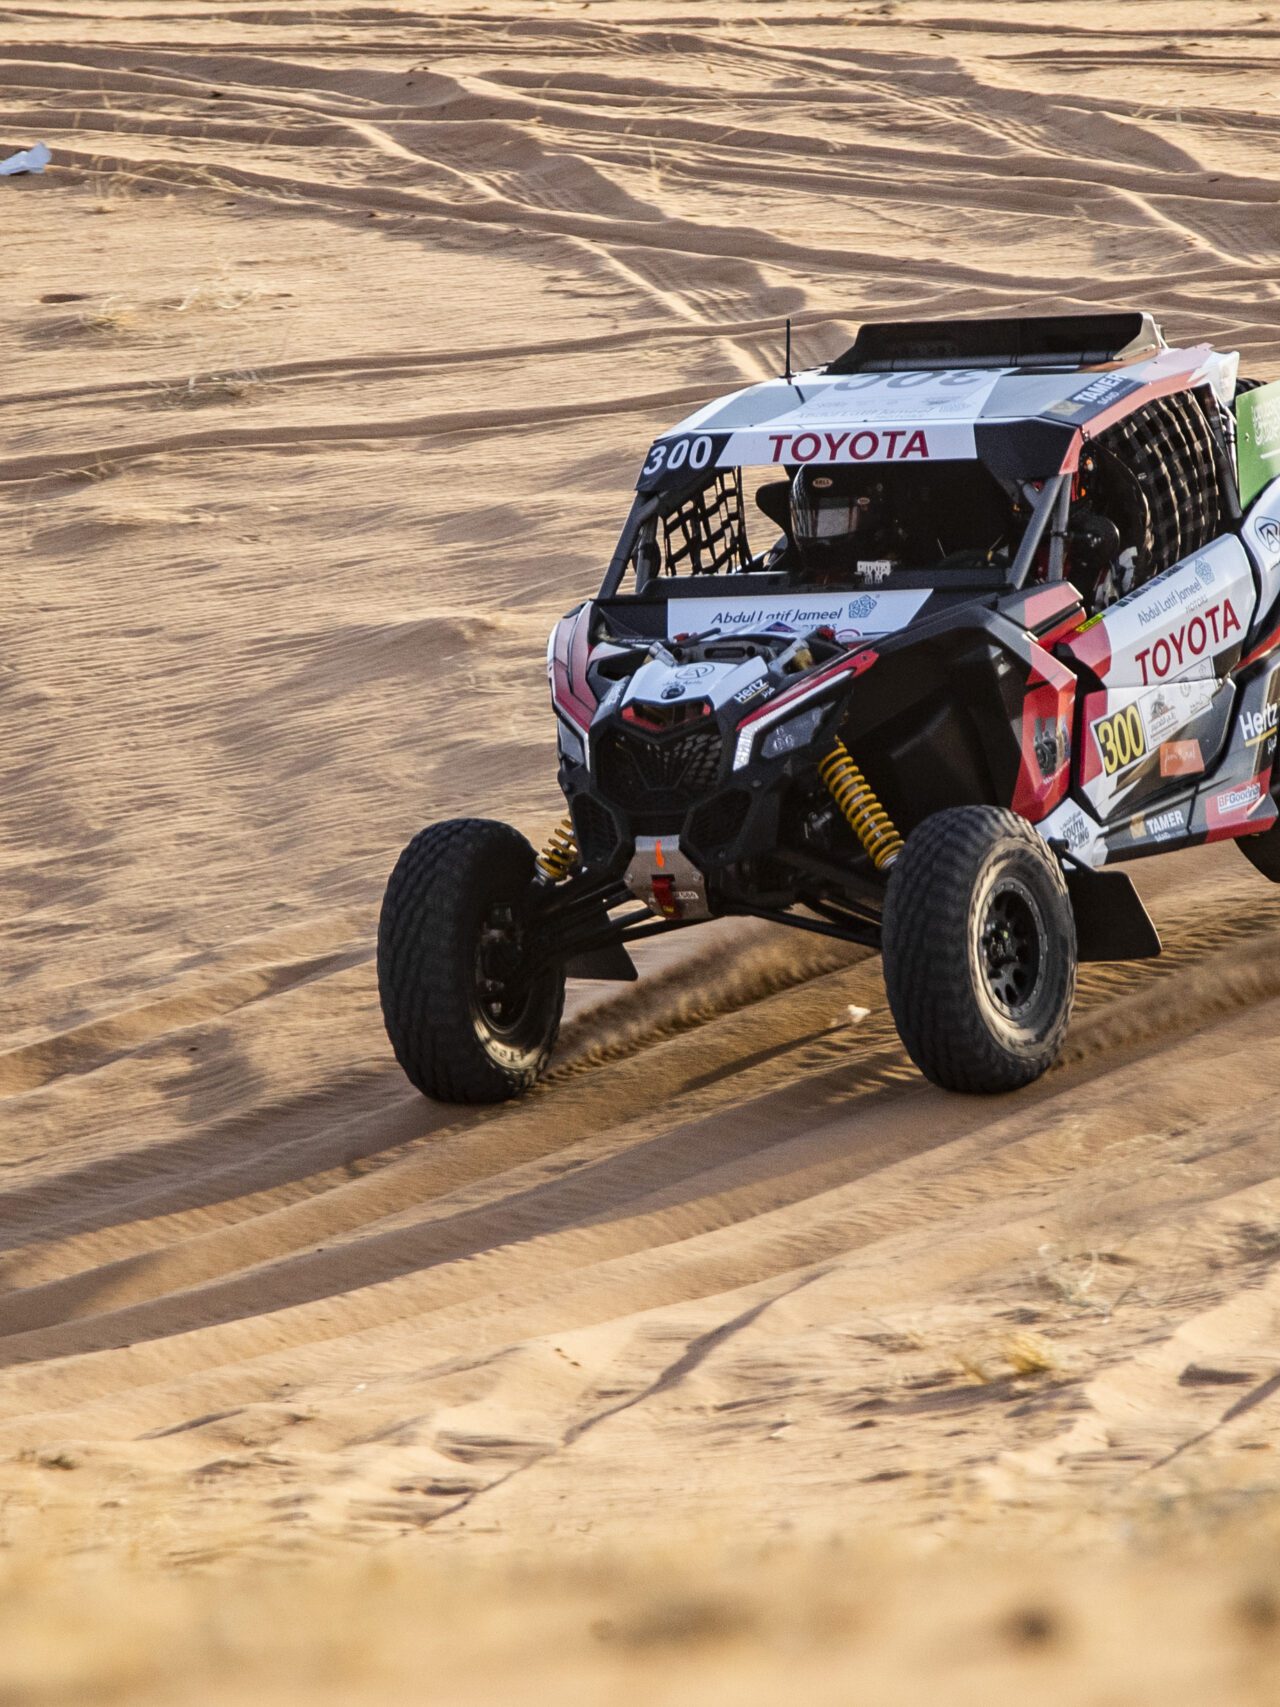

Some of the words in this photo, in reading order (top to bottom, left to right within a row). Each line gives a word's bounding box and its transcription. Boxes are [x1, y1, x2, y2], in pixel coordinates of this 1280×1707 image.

[1072, 372, 1129, 402] TAMER
[643, 435, 712, 475] 300
[768, 430, 930, 462] TOYOTA
[711, 610, 756, 624] Abdul
[790, 607, 843, 622] Jameel
[1137, 601, 1161, 626] Abdul
[1157, 590, 1176, 612] Latif
[1174, 576, 1202, 604] Jameel
[1135, 598, 1241, 685] TOYOTA
[733, 679, 769, 702] Hertz
[1239, 702, 1279, 740] Hertz
[1098, 704, 1146, 774] 300
[1146, 810, 1184, 835] TAMER
